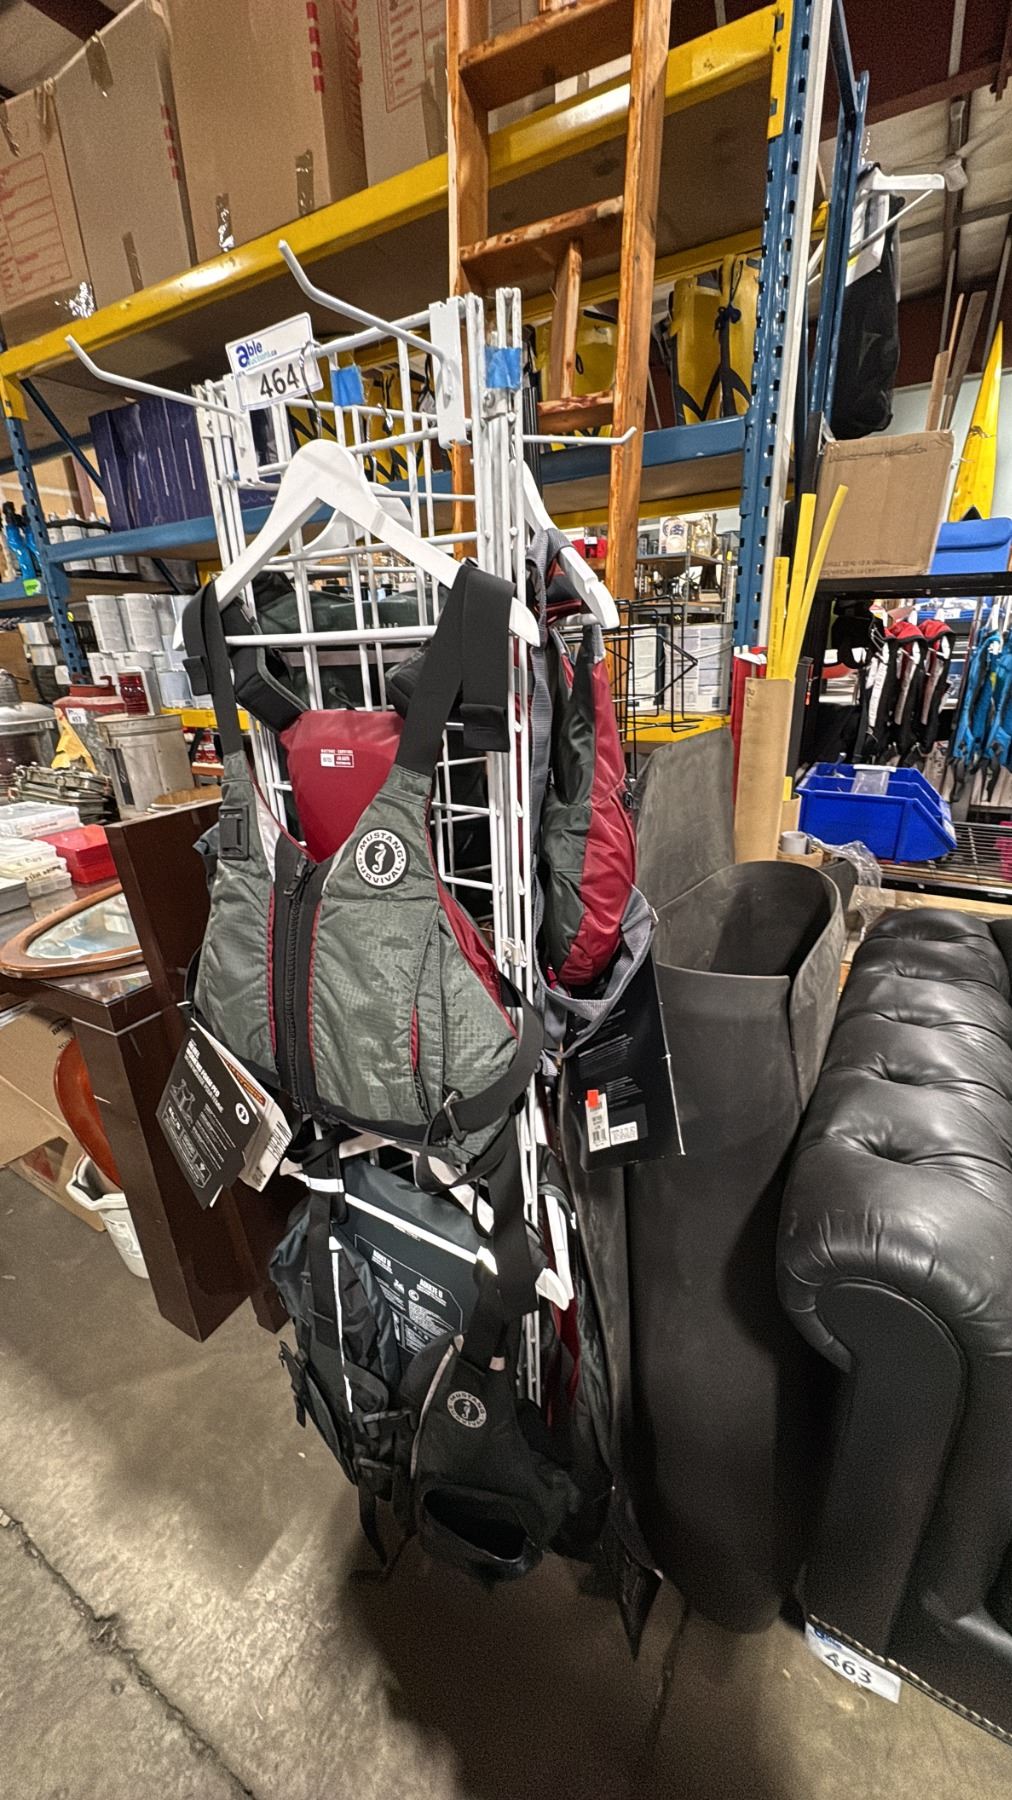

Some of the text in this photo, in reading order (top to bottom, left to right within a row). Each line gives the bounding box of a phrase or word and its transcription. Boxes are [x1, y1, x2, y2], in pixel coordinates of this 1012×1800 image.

[236, 340, 262, 367] able
[260, 363, 299, 397] 464
[360, 832, 403, 858] MUSTANG
[358, 858, 402, 883] SURVIVAL
[824, 1652, 871, 1683] 463
